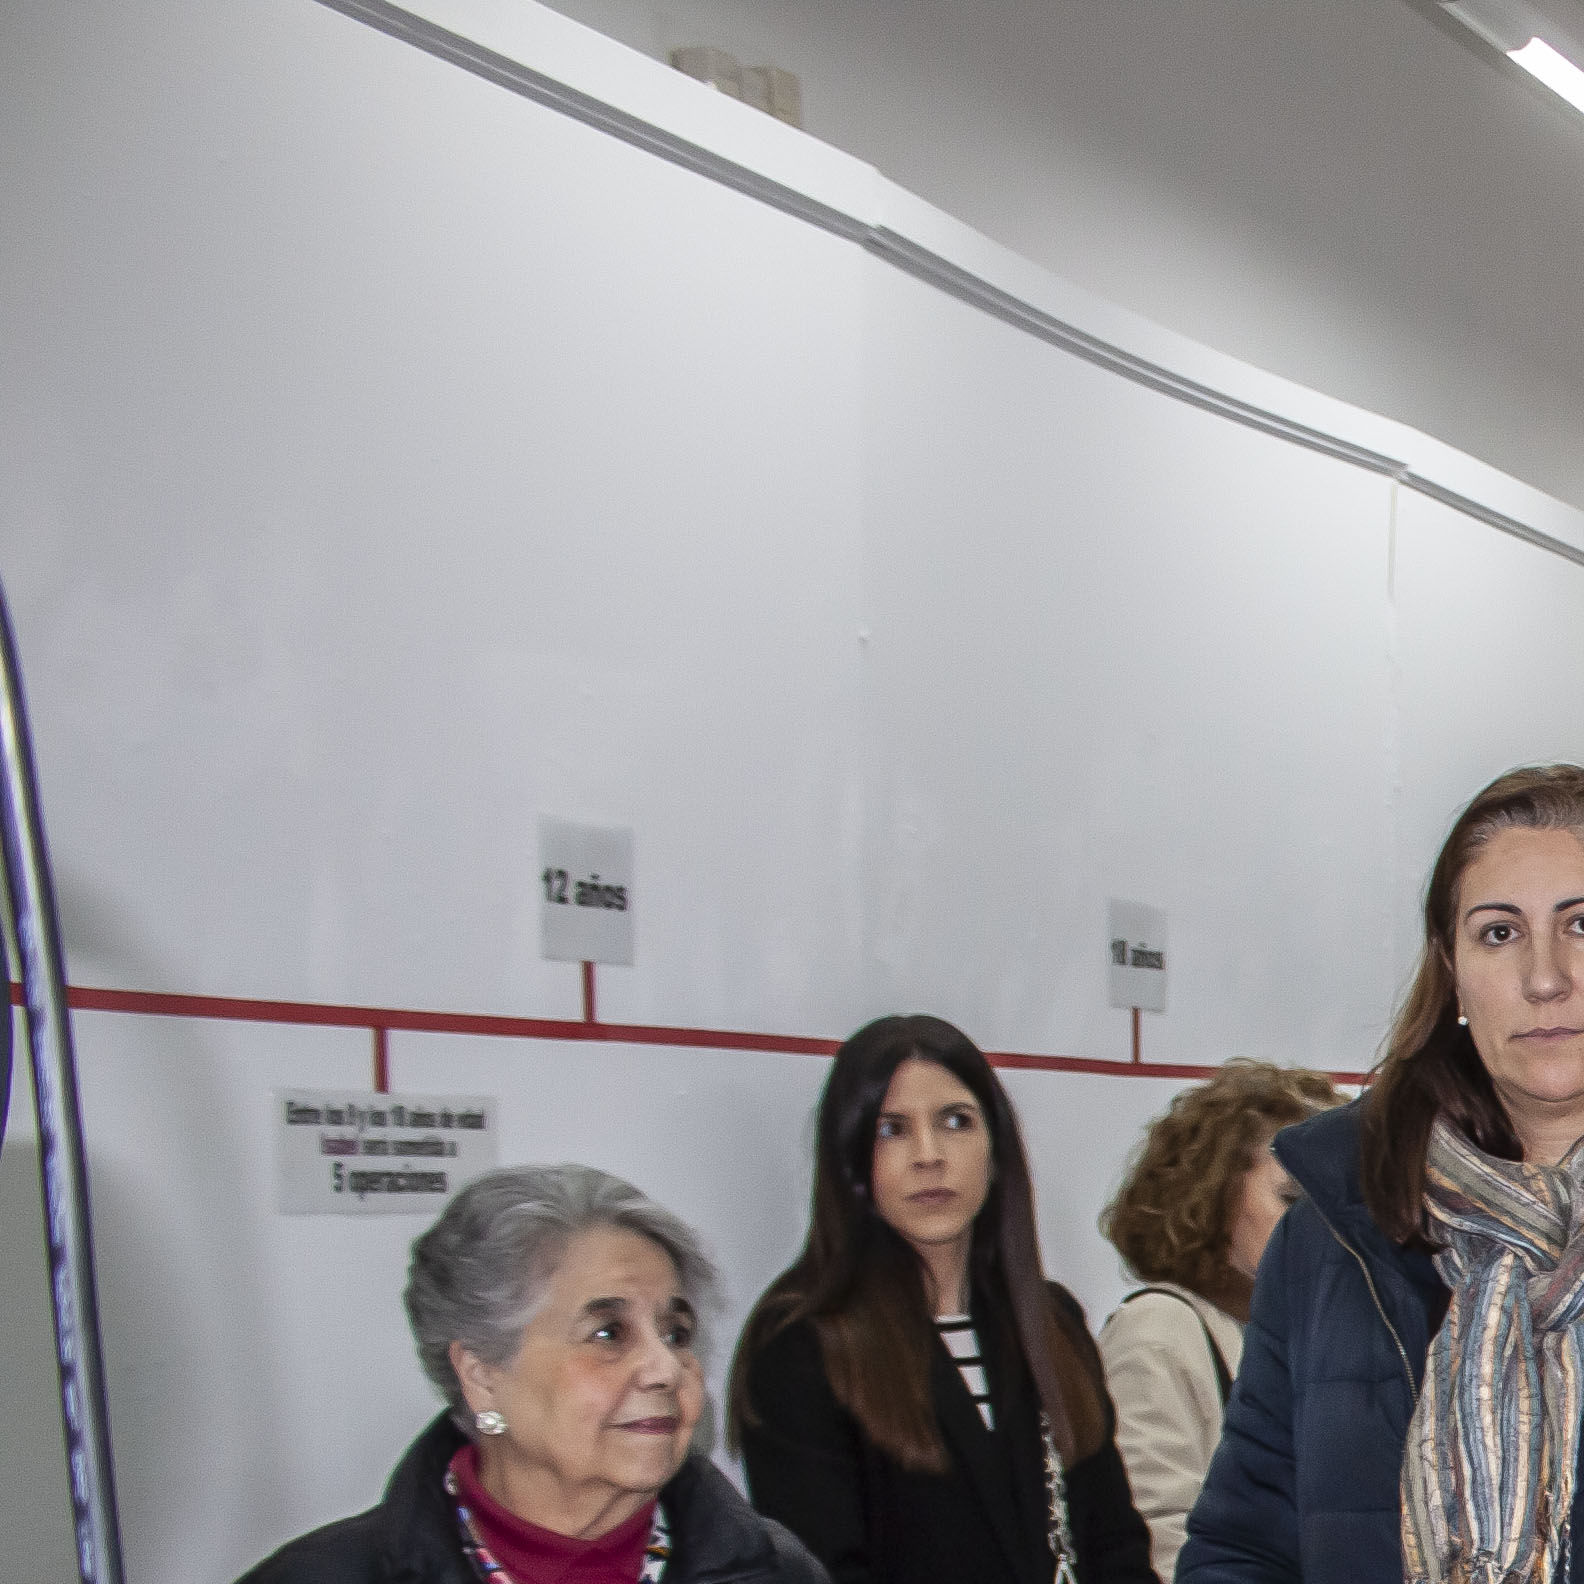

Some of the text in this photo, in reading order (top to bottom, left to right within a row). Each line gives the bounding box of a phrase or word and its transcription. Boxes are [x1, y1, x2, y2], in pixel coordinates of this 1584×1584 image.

[541, 867, 628, 912] 12 años
[1130, 942, 1166, 971] años
[332, 1161, 447, 1201] 5 operaciones
